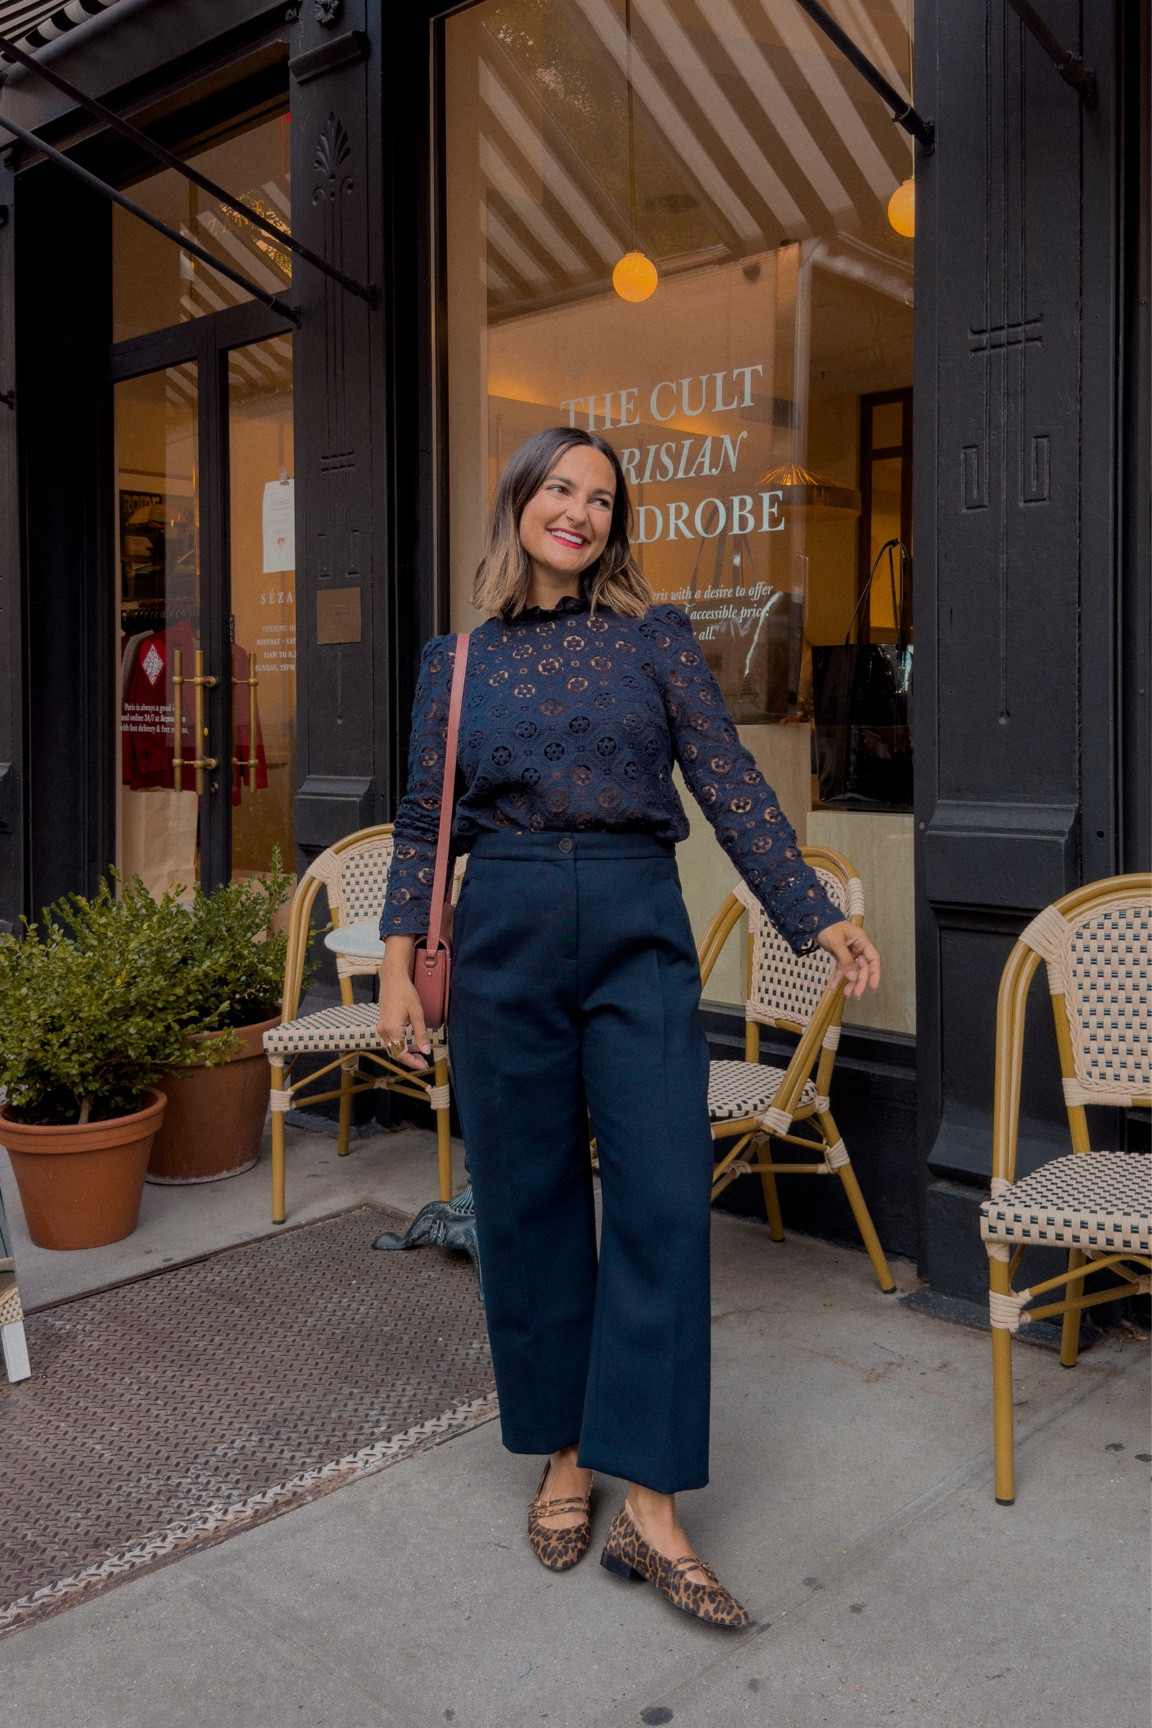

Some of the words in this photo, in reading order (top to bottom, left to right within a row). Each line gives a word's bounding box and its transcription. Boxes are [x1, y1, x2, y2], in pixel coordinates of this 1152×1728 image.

[560, 387, 640, 433] THE
[650, 364, 763, 422] CULT
[621, 430, 748, 486] RISIAN
[629, 490, 785, 545] DROBE
[671, 586, 692, 601] with
[694, 590, 701, 599] a
[704, 584, 733, 599] desire
[735, 585, 745, 597] to
[748, 581, 774, 602] offer
[690, 604, 738, 620] accessible
[256, 638, 281, 646] MONDAY
[698, 626, 716, 641] all.
[279, 650, 287, 658] TO
